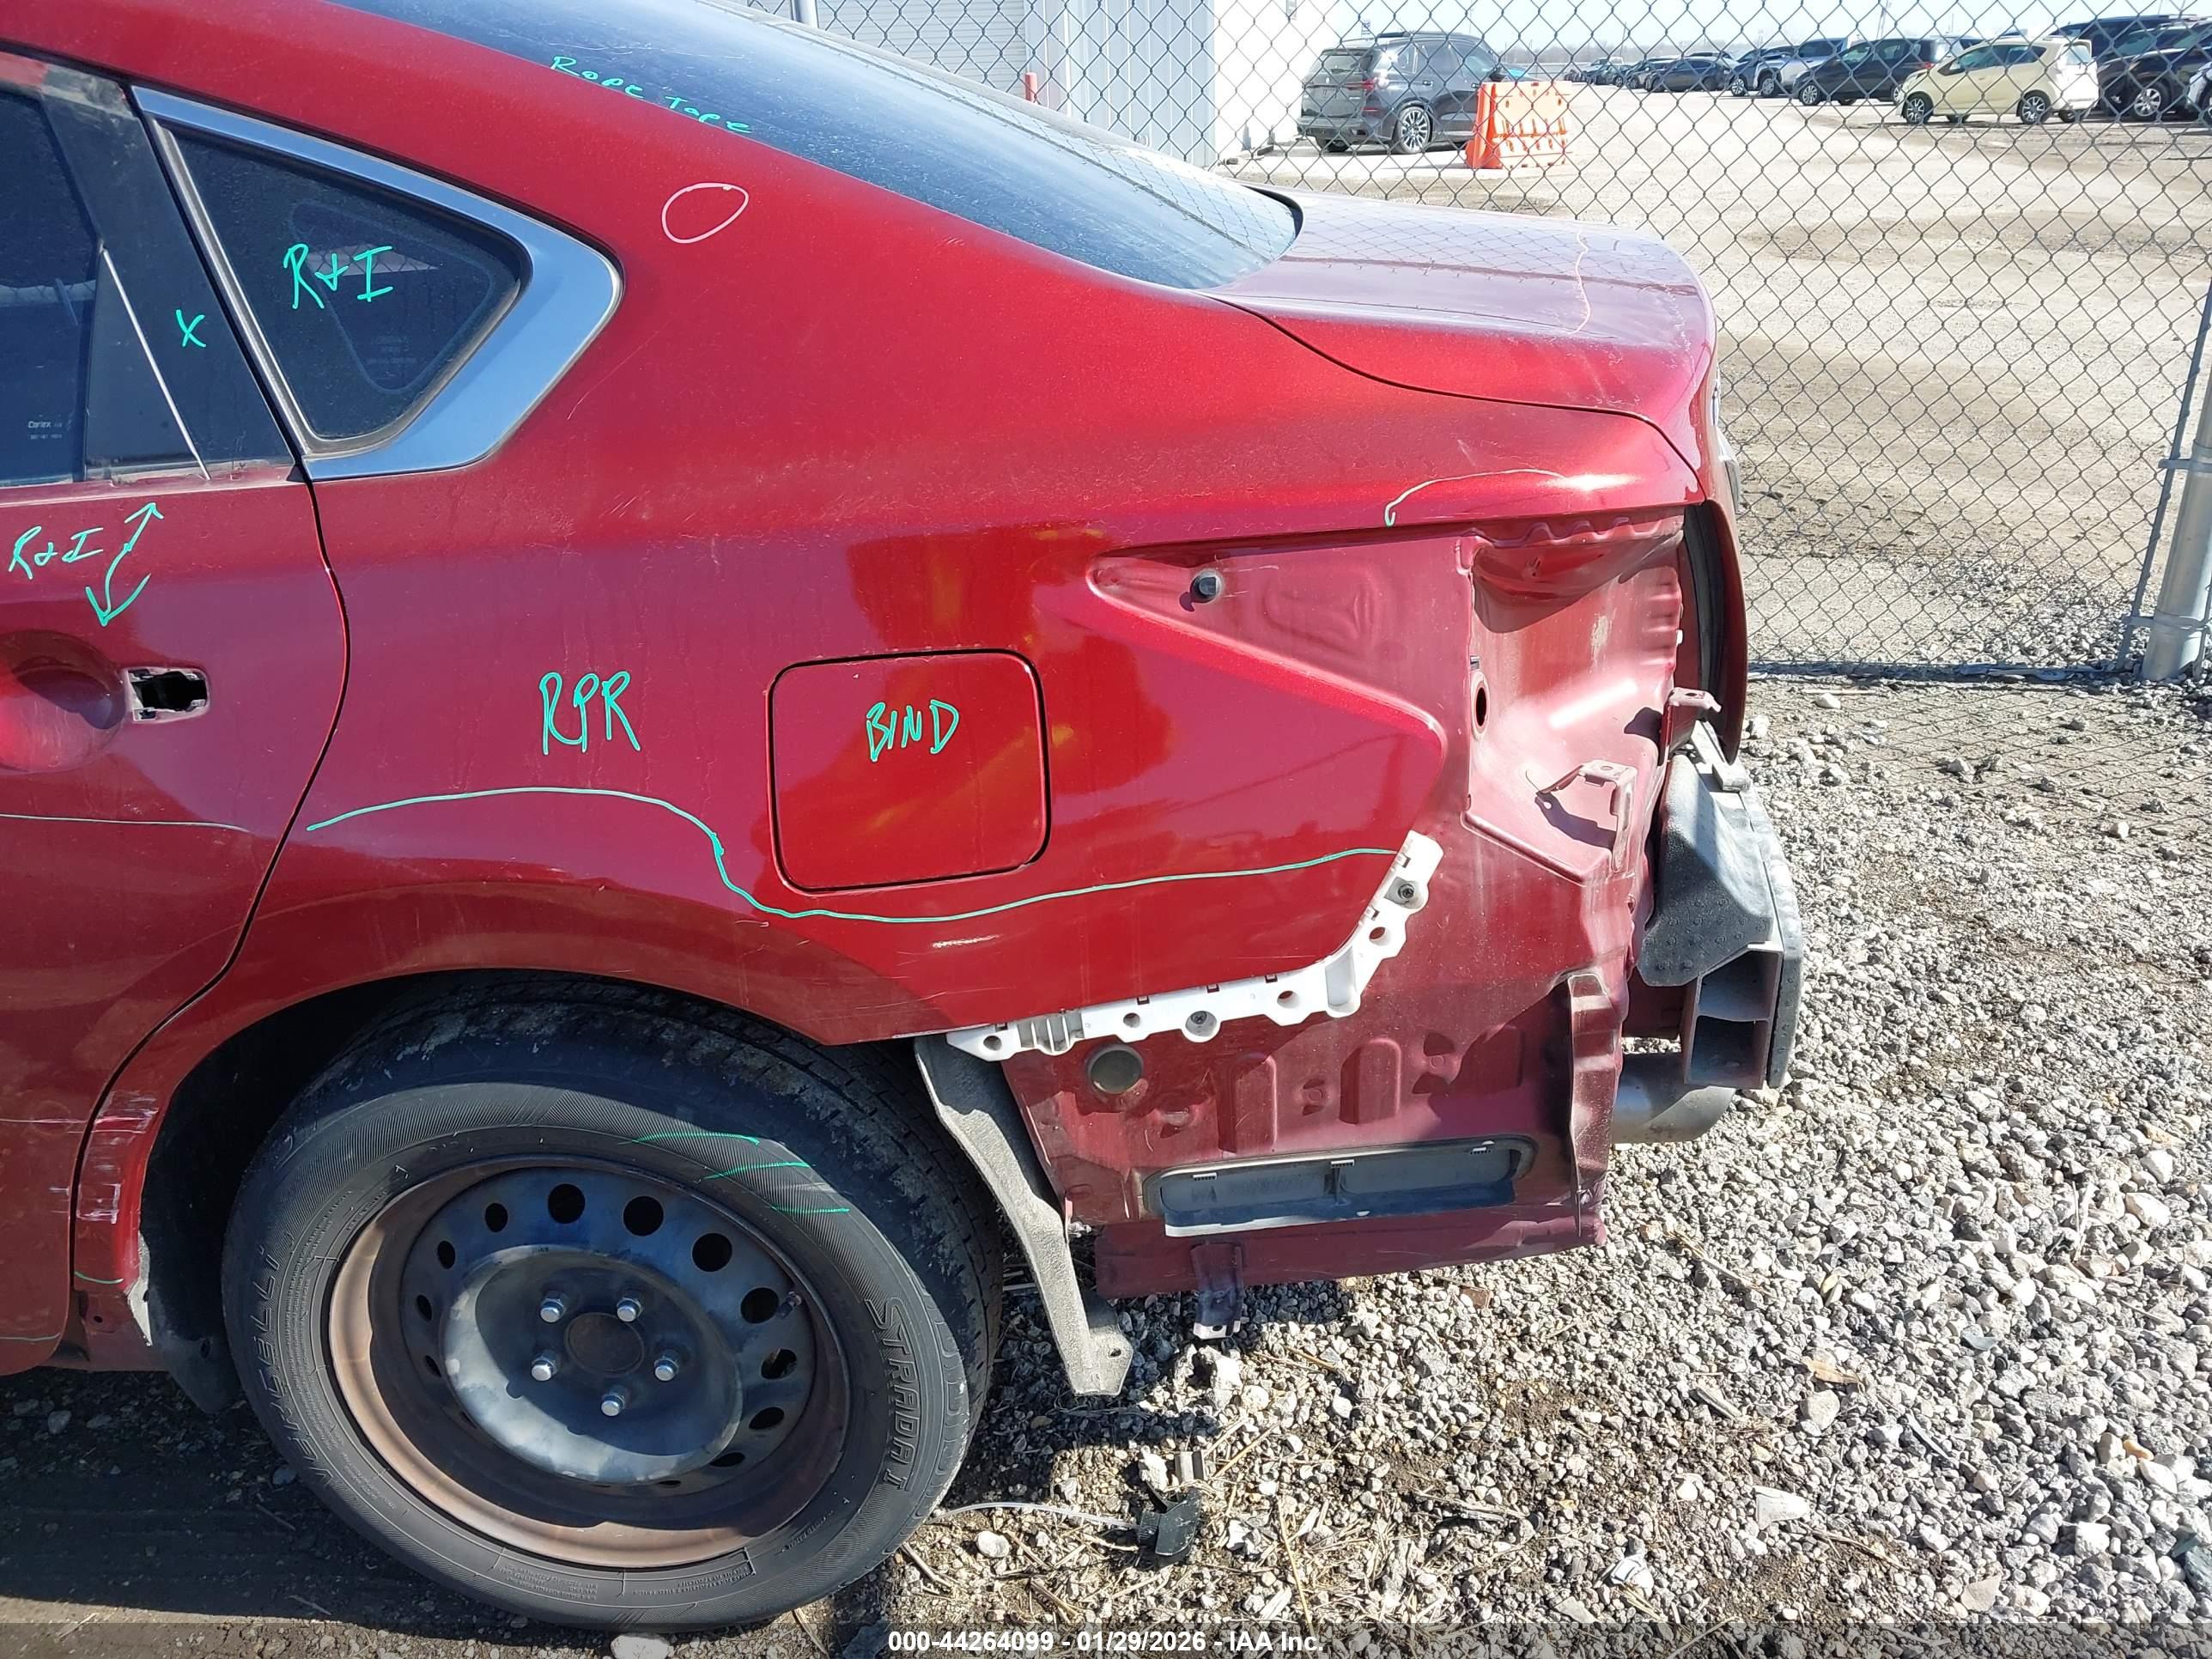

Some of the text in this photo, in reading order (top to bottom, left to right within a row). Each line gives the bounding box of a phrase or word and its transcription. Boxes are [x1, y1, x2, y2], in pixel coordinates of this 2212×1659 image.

[550, 56, 753, 134] Rope Tape
[539, 672, 641, 756] RPR
[866, 699, 959, 762] BIND
[863, 1297, 921, 1465] STRADA
